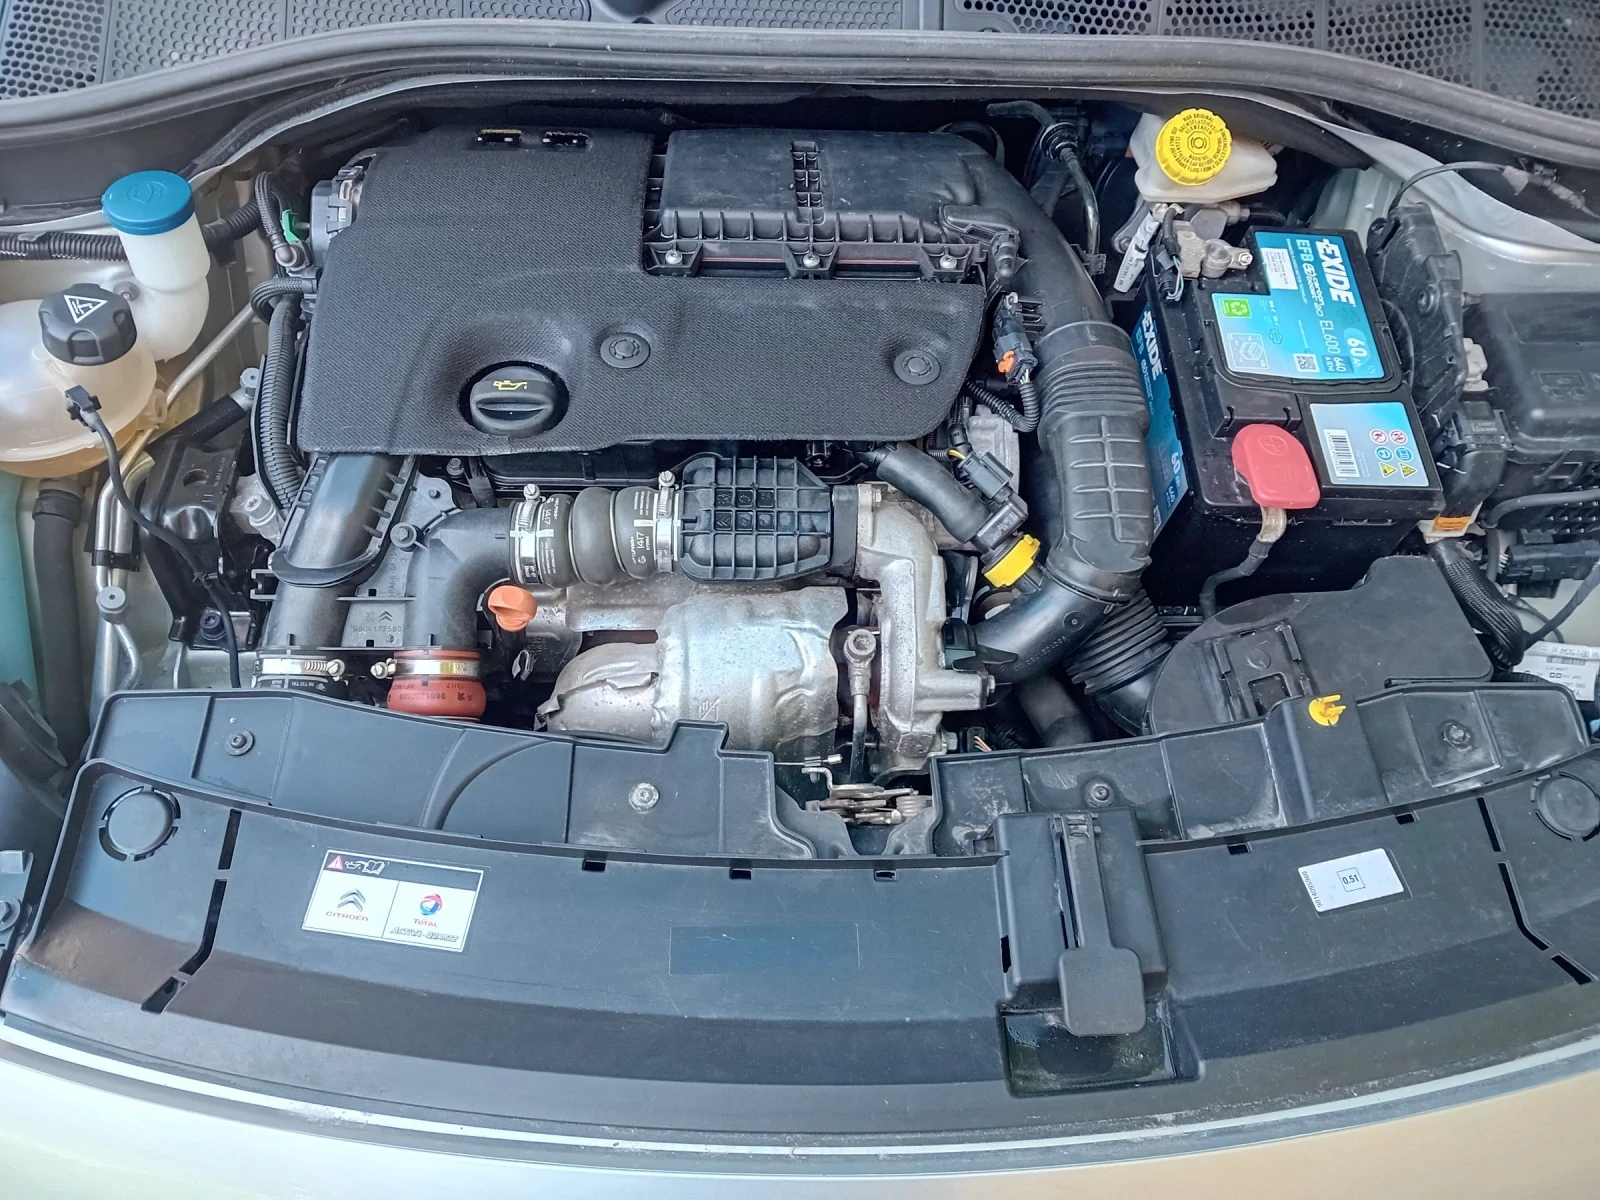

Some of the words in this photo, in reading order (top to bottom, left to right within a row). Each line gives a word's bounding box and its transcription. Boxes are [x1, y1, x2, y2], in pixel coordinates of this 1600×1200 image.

[1194, 114, 1214, 122] ORIGINAL
[1296, 239, 1314, 262] EFB
[1316, 238, 1356, 305] EXIDE
[1142, 311, 1163, 380] EXIDE
[1320, 320, 1340, 354] EL600
[1348, 337, 1368, 358] 60
[1333, 356, 1347, 372] 640
[1352, 358, 1361, 368] Ah
[636, 531, 644, 548] 1417
[1342, 874, 1359, 885] 0.51
[413, 919, 438, 927] TOTAL
